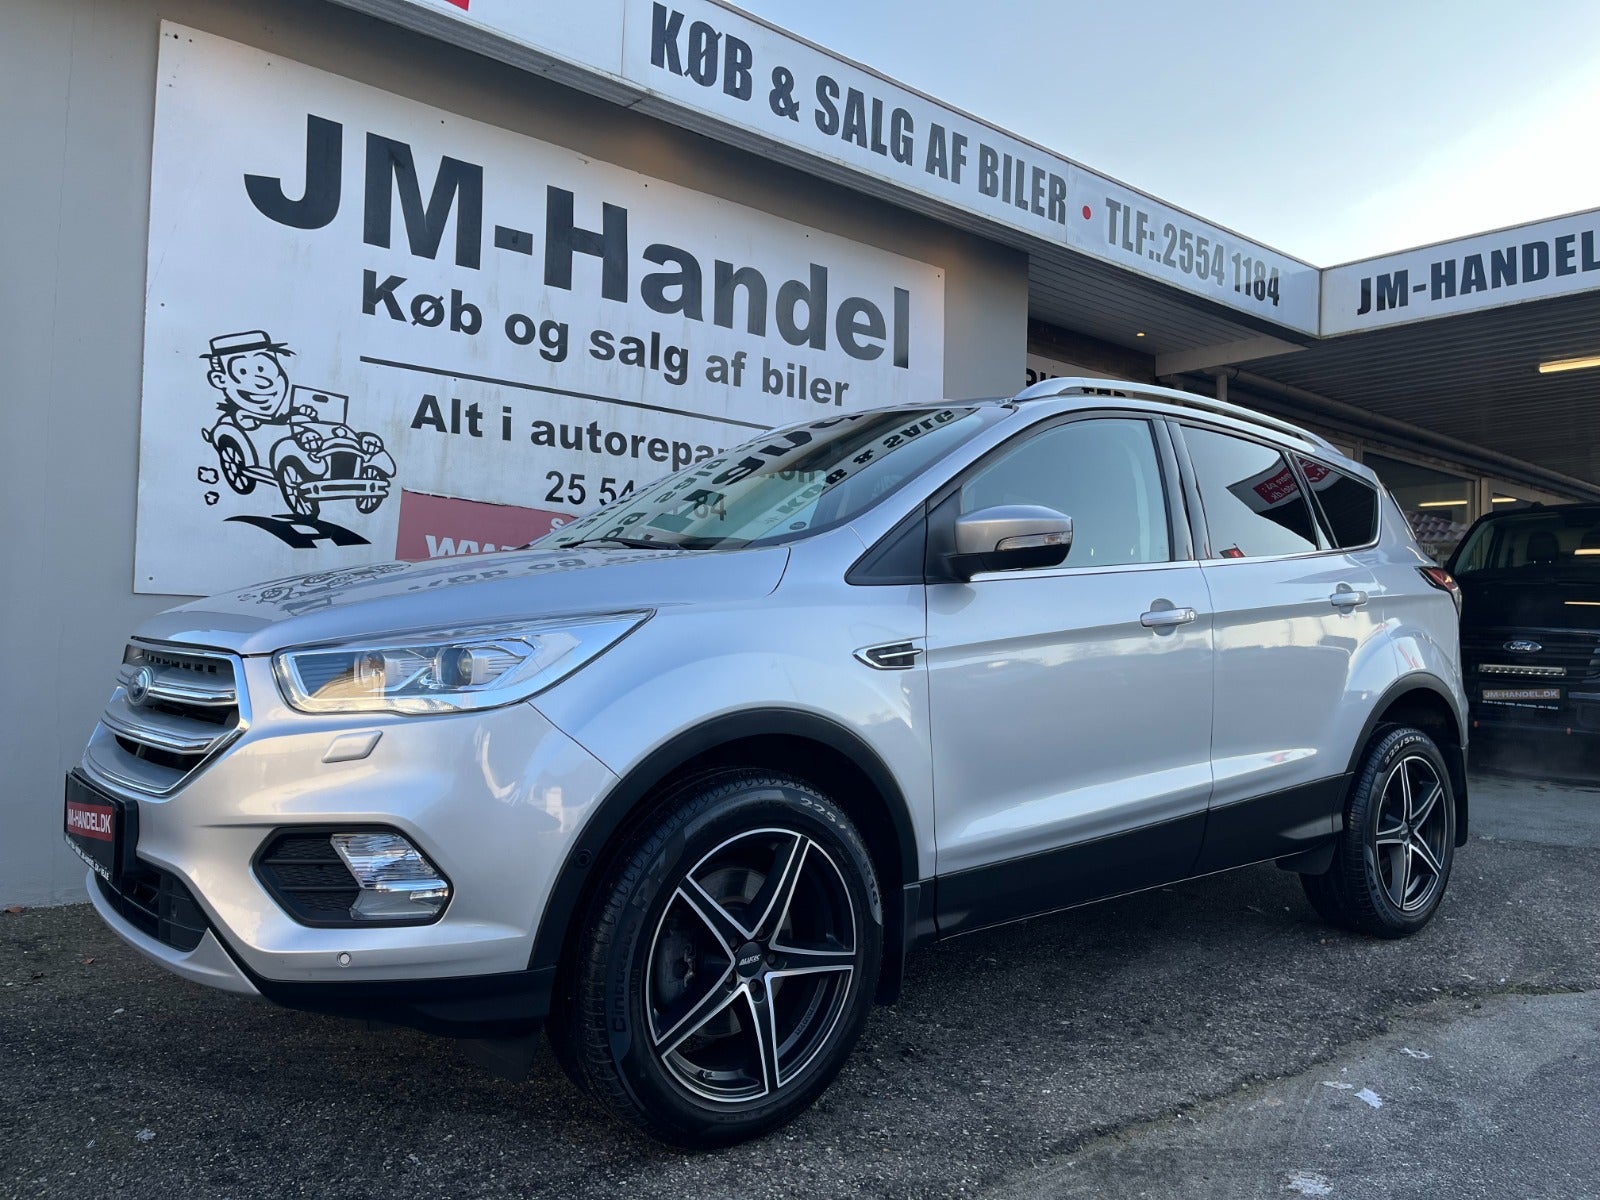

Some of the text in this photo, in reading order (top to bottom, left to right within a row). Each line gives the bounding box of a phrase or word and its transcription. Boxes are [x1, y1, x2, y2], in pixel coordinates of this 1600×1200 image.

[650, 2, 753, 102] KØB
[769, 66, 800, 122] &
[815, 75, 914, 167] SALG
[925, 122, 968, 185] AF
[978, 143, 1067, 225] BILER
[1232, 252, 1280, 307] 1184
[244, 113, 910, 369] JM-Handel
[1357, 230, 1600, 316] JM-HANDEL
[362, 269, 850, 407] Køb og salg af biler
[410, 394, 484, 438] Alt
[502, 405, 512, 441] i
[545, 470, 587, 505] 25
[1486, 689, 1558, 699] JM-HANDEL.DK
